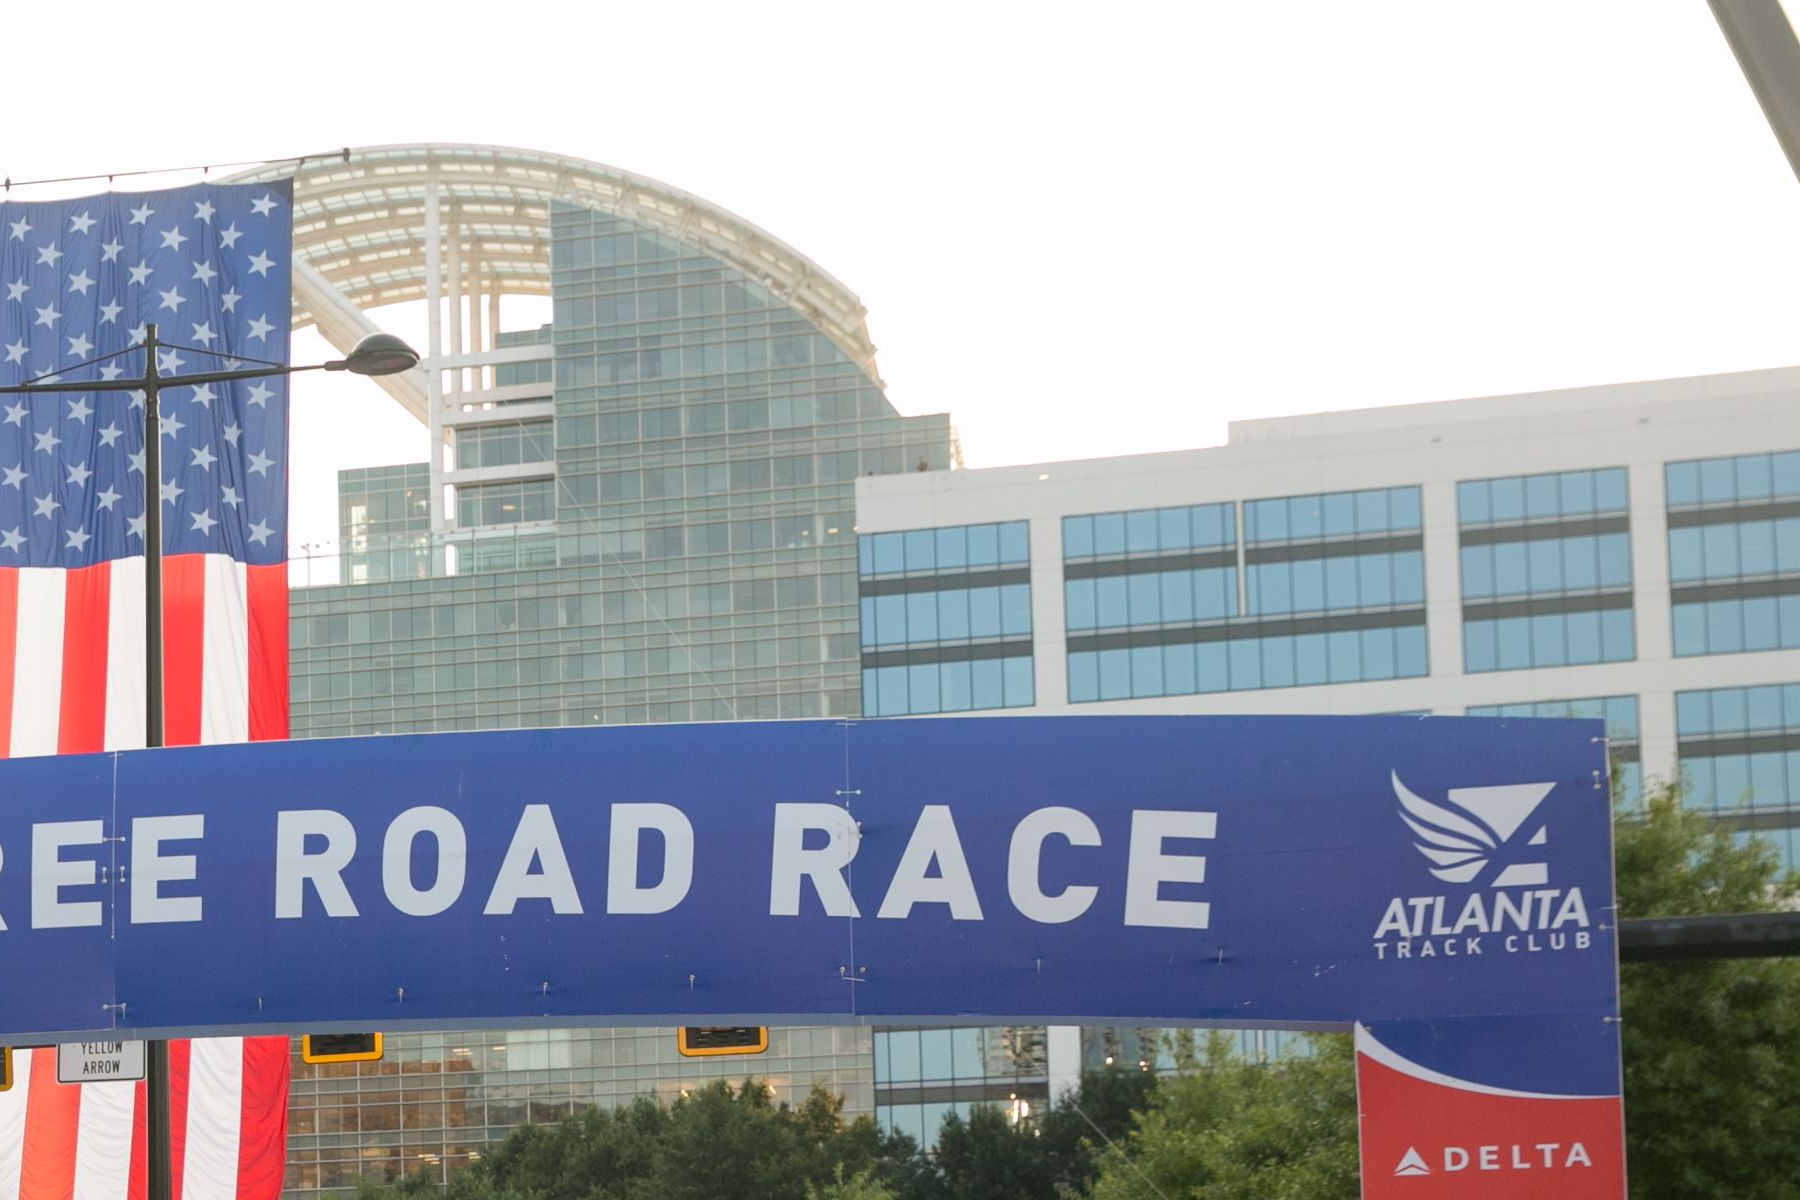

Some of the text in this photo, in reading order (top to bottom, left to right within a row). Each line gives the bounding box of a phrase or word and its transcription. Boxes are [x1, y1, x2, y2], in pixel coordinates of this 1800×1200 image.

[275, 803, 694, 918] ROAD
[769, 802, 1218, 929] RACE
[1373, 886, 1590, 939] ATLANTA
[1374, 931, 1591, 960] TRACK CLUB
[81, 1041, 123, 1055] YELLOW
[83, 1061, 121, 1075] ARROW
[1444, 1142, 1592, 1172] DELTA
